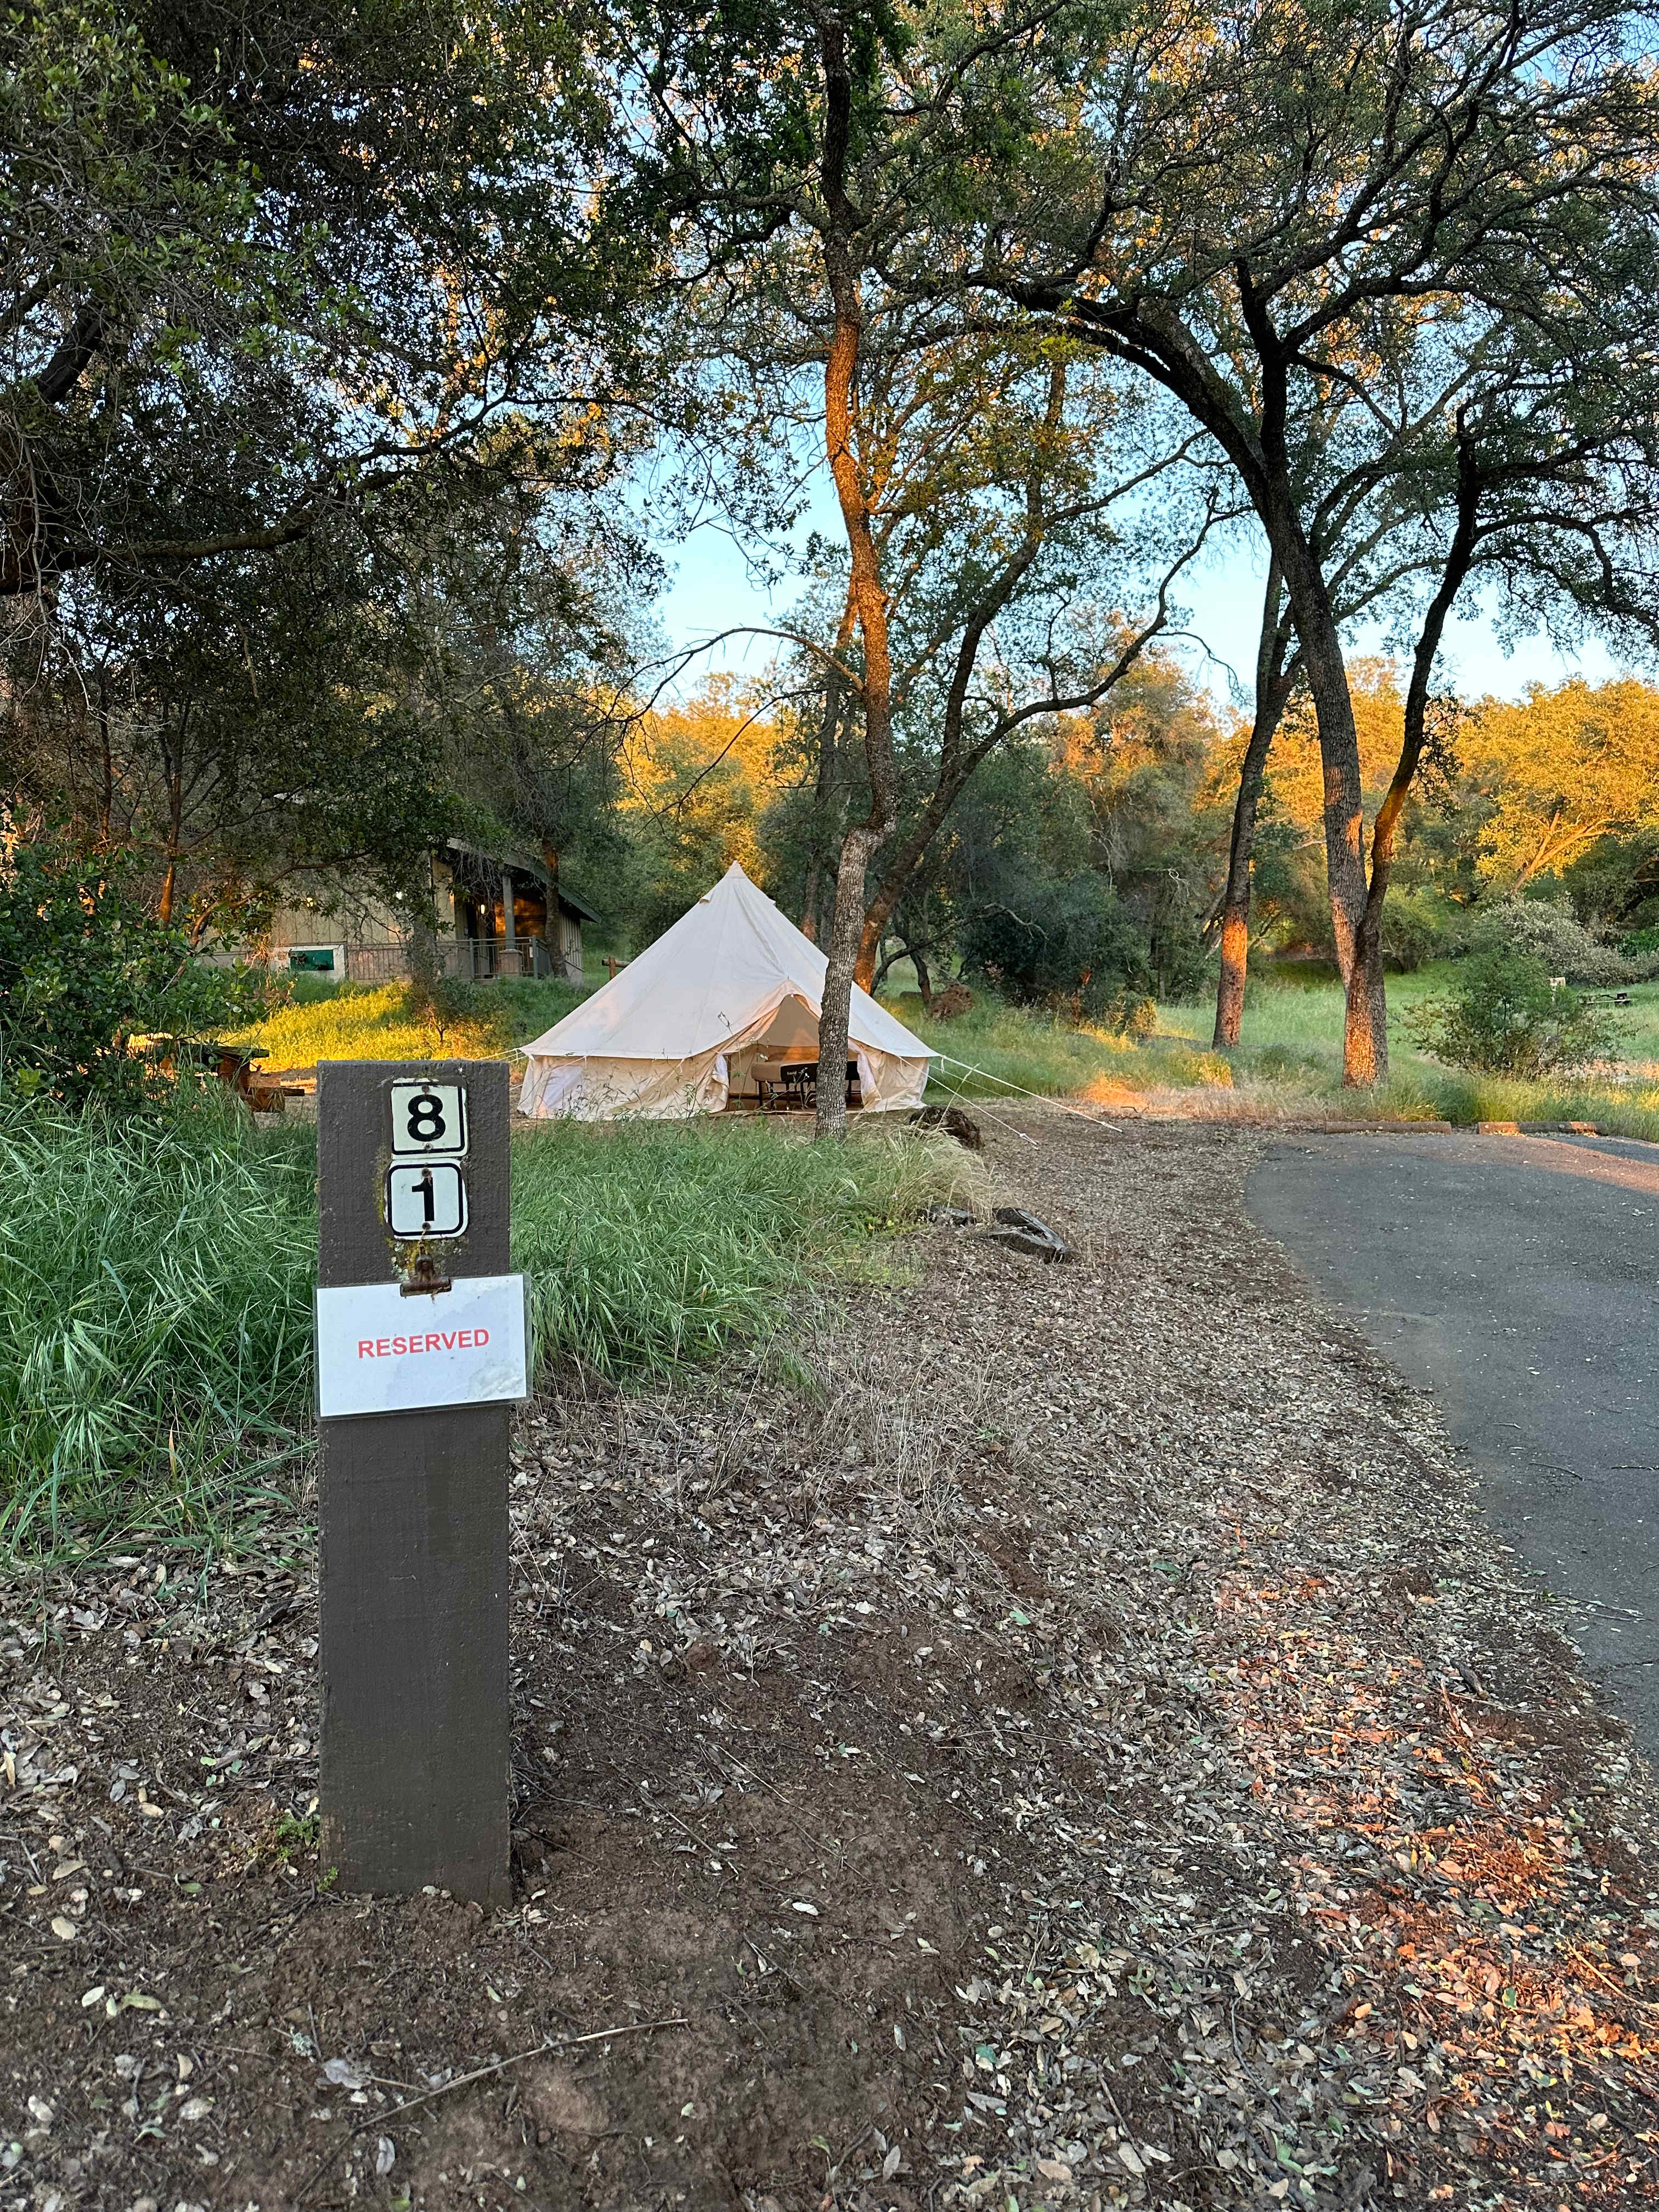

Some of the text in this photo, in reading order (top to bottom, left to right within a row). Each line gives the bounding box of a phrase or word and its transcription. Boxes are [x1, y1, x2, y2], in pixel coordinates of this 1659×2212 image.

[408, 1094, 446, 1142] 8
[412, 1176, 435, 1222] 1
[358, 1328, 489, 1358] RESERVED
